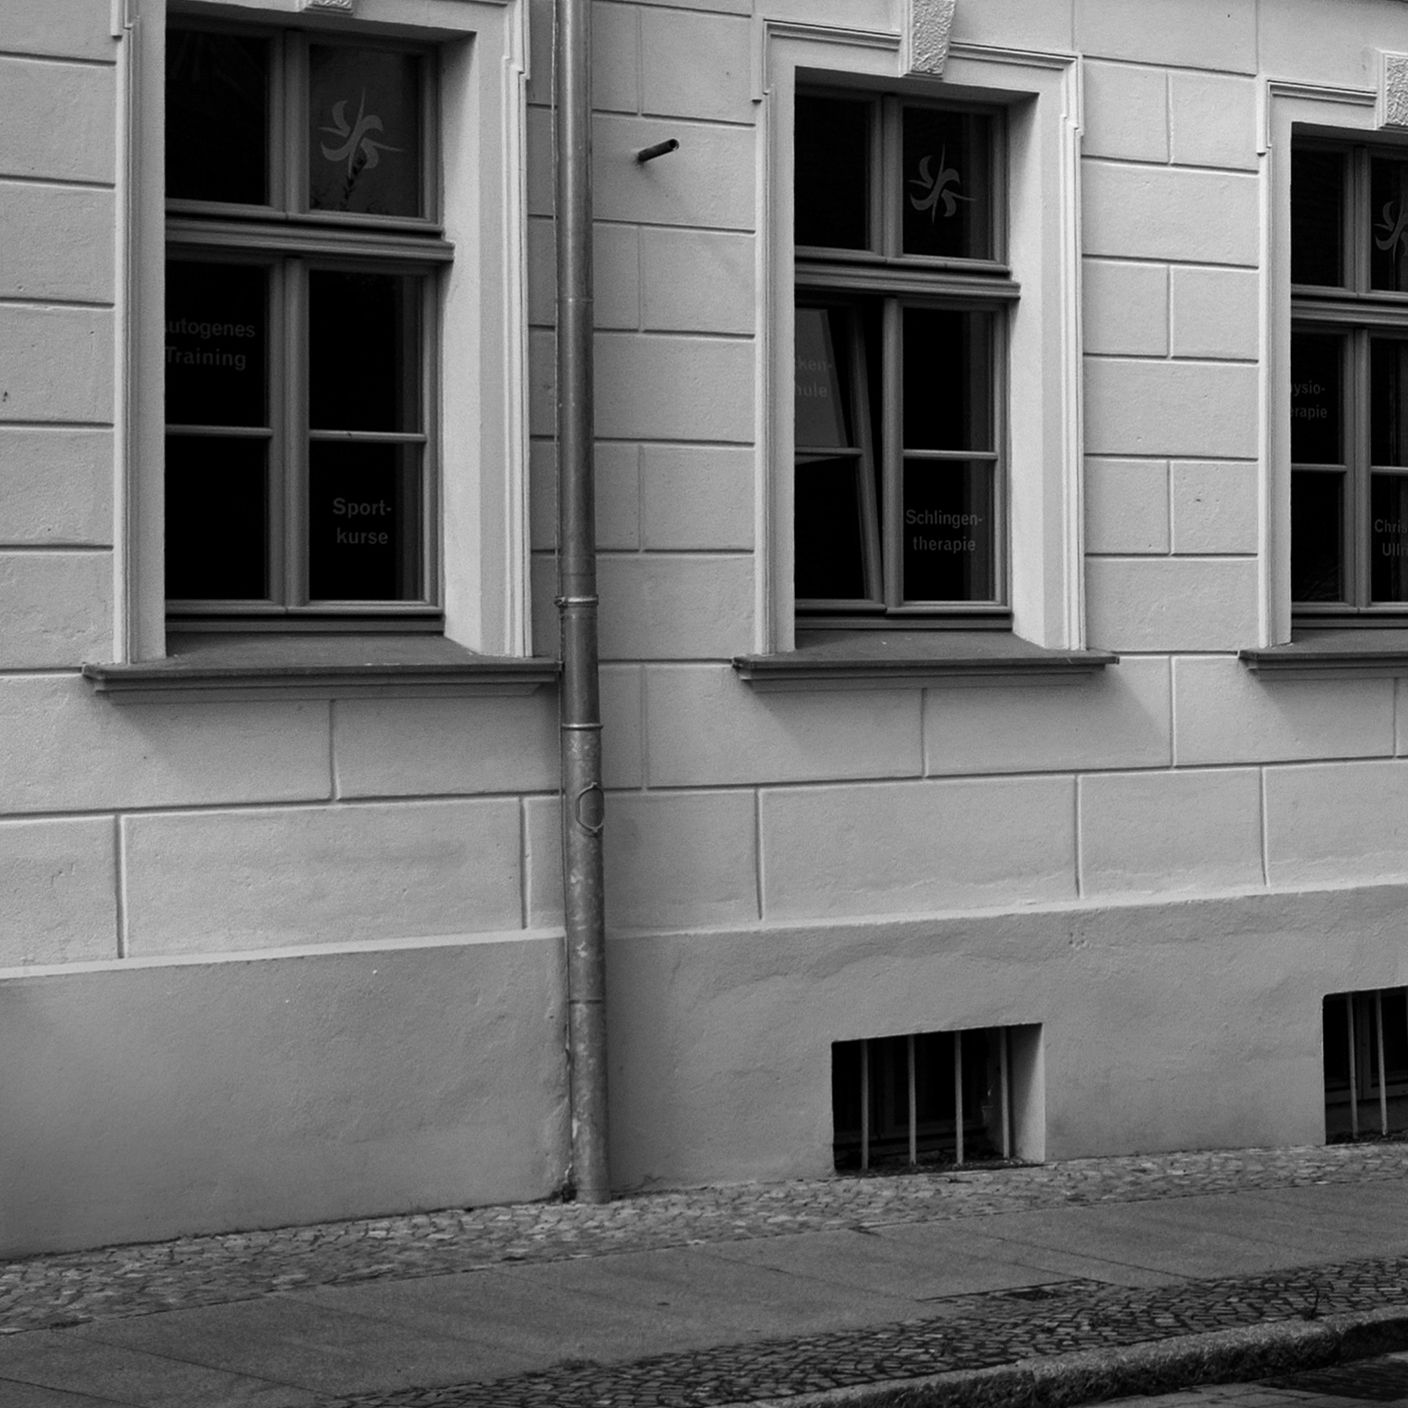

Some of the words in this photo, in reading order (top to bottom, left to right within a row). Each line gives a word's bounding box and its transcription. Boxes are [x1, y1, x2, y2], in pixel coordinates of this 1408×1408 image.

[166, 317, 256, 340] utogenes
[166, 346, 247, 371] Training
[796, 355, 833, 372] ken-
[1292, 379, 1326, 398] ysio-
[332, 497, 392, 519] Sport-
[905, 509, 983, 529] Schlingen-
[336, 526, 389, 545] kurse
[912, 536, 976, 554] therapie
